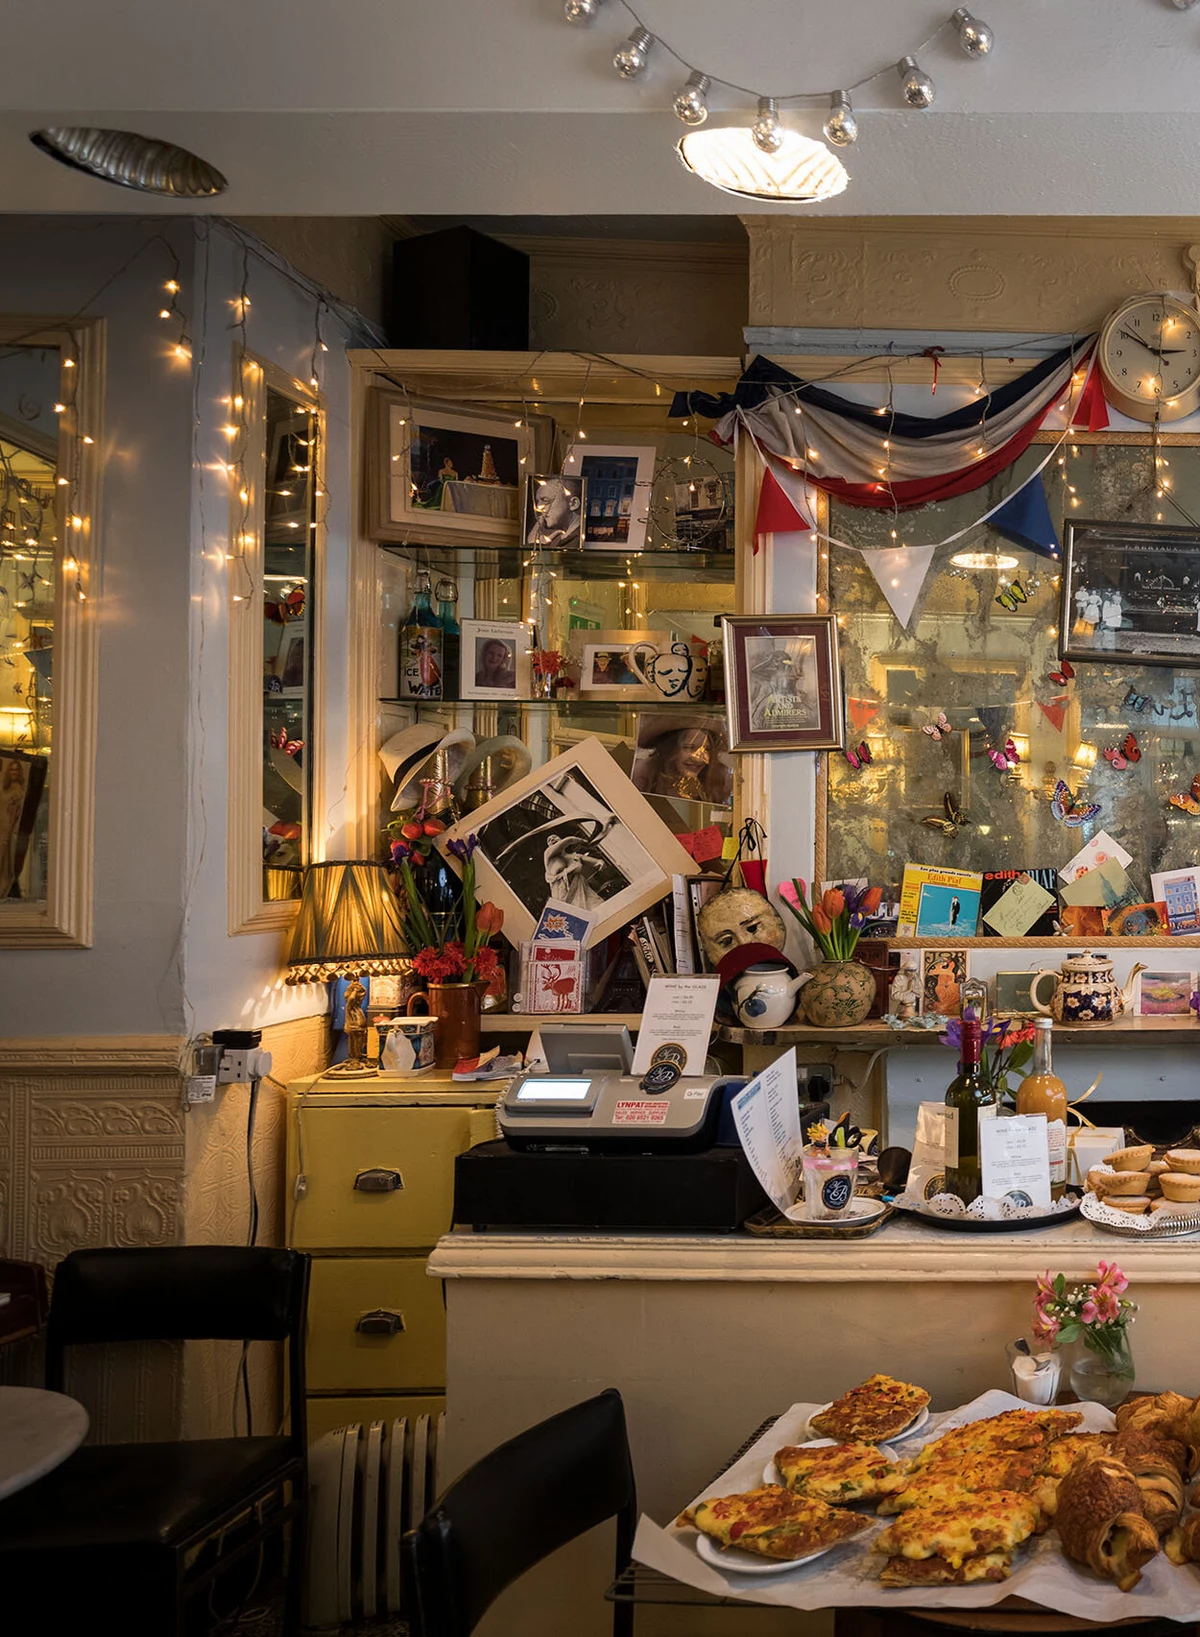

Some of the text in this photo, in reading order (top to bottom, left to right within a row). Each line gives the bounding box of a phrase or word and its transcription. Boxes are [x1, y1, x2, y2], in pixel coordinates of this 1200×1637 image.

[1152, 314, 1160, 322] 12
[1134, 319, 1140, 327] 11
[1120, 332, 1129, 340] 10
[403, 668, 419, 677] ICE
[763, 708, 807, 717] ADMIRERS
[985, 868, 1056, 889] edith PIAF
